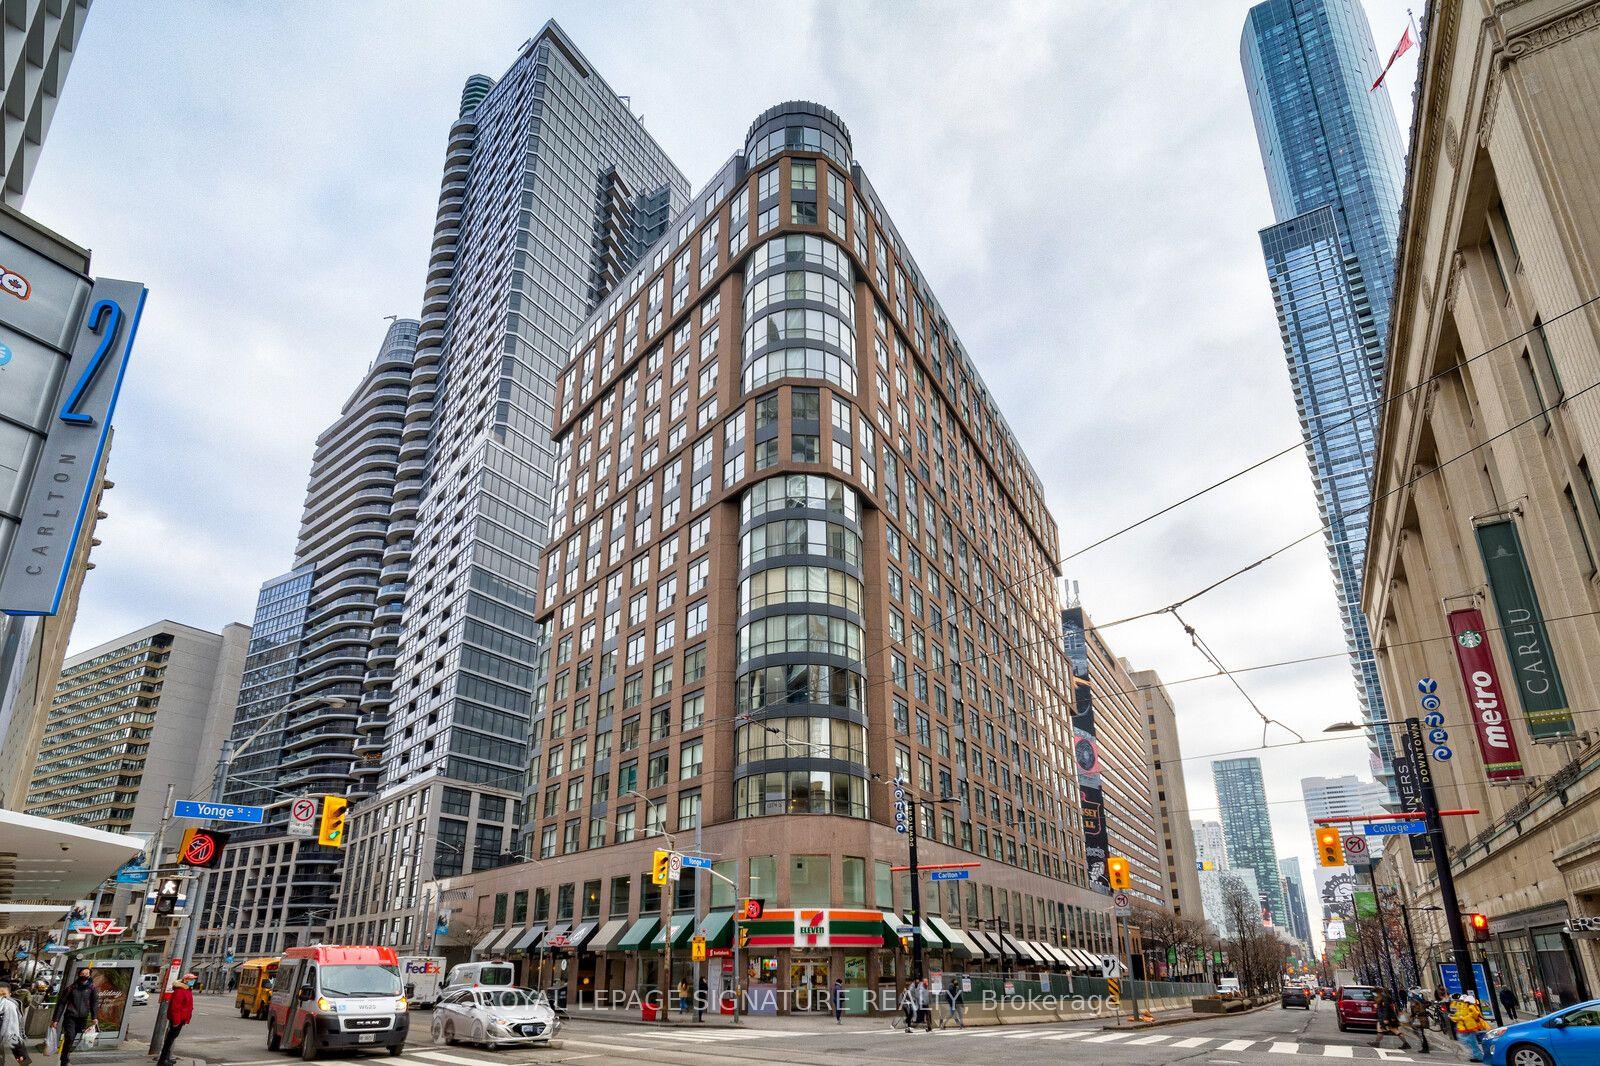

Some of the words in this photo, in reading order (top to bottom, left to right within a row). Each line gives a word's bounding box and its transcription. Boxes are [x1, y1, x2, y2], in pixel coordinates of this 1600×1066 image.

[60, 299, 121, 423] 2
[25, 453, 77, 576] CARLTON
[1508, 608, 1549, 695] CARLU
[1471, 670, 1510, 749] metro
[1413, 723, 1430, 783] DOWNTOWN
[197, 803, 234, 819] Yonge
[907, 804, 915, 847] DOWNTOWN
[1372, 823, 1409, 834] College
[801, 911, 824, 944] 7
[405, 962, 441, 975] FedEx
